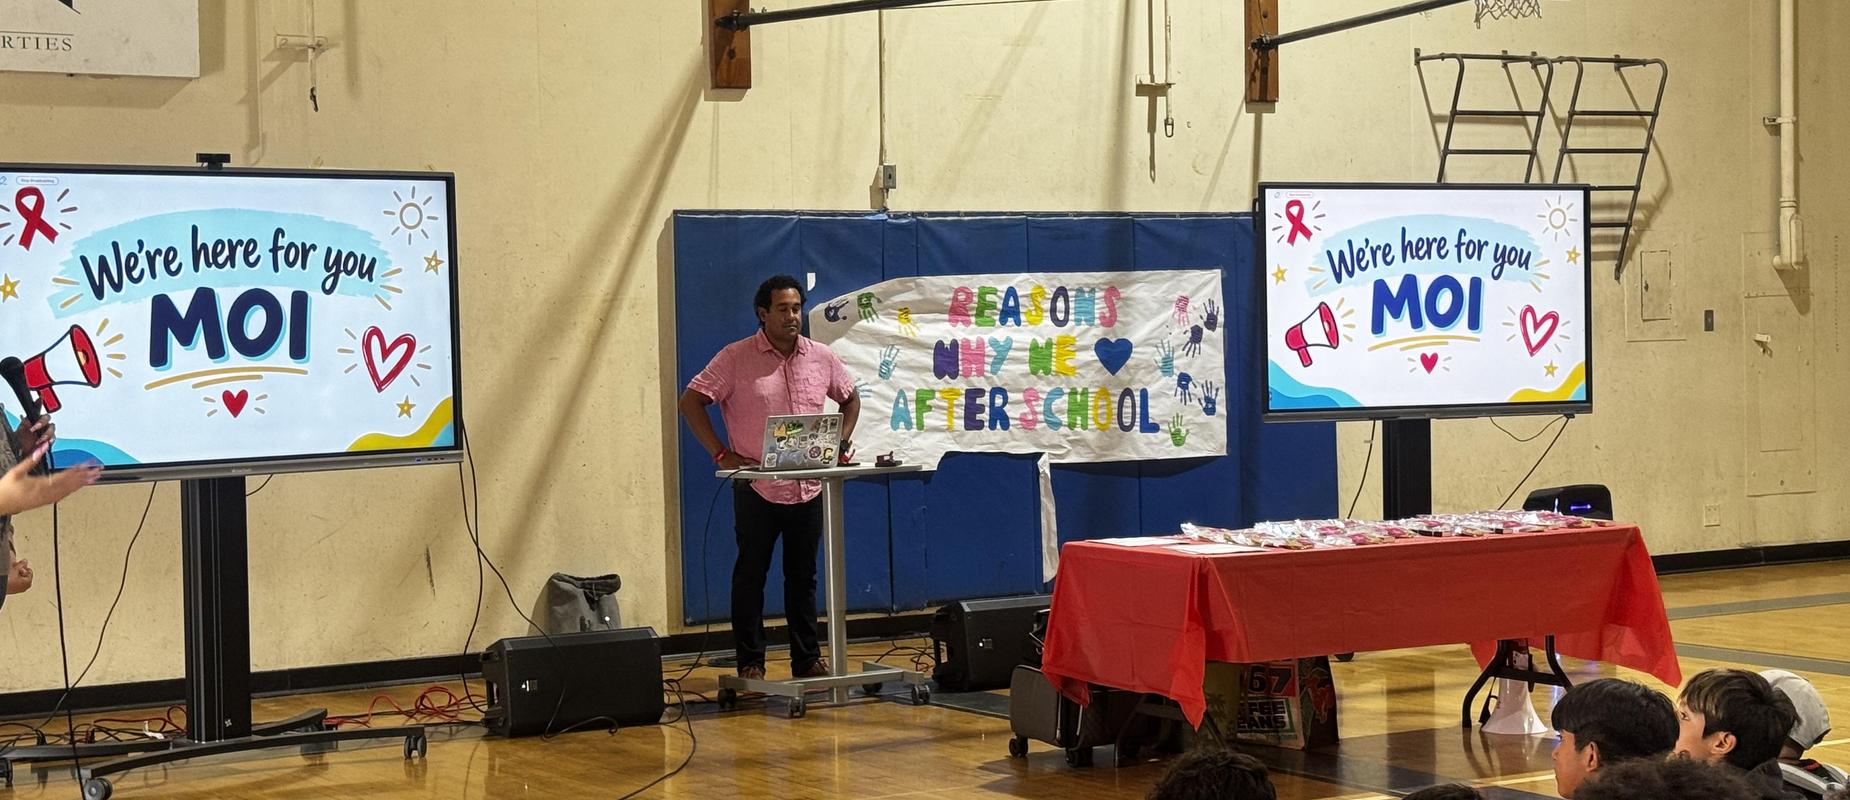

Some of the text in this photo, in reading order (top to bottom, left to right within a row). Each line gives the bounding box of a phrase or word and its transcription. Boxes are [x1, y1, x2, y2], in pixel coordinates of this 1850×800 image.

[1, 35, 73, 52] RTIES
[80, 224, 377, 300] We're here for you
[1326, 227, 1531, 284] We're here for you
[150, 286, 311, 369] MOI
[948, 285, 1122, 328] REASONS
[1371, 273, 1483, 336] MOI
[933, 335, 1078, 380] WHY WE
[890, 386, 1160, 433] AFTER SCHOOL
